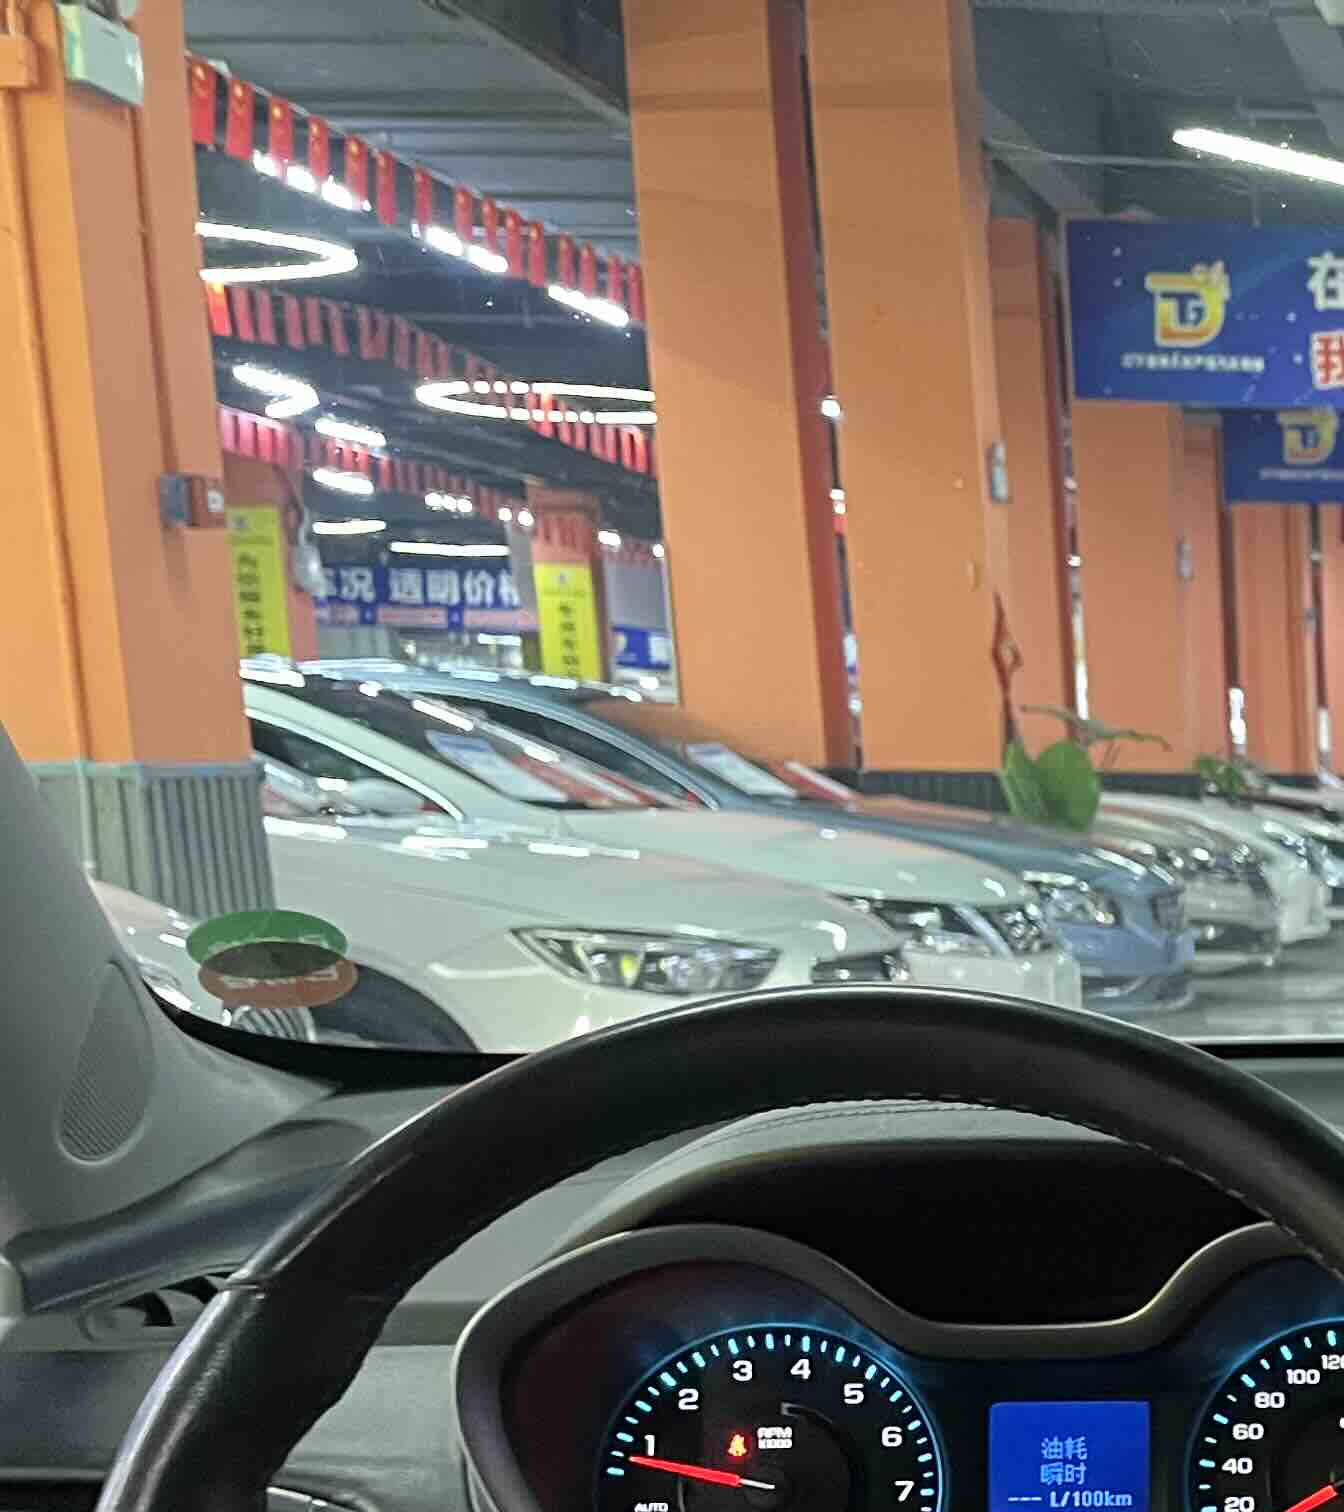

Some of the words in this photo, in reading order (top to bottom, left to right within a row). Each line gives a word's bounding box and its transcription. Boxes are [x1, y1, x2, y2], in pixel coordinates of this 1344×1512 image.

[733, 1361, 752, 1381] 3
[791, 1359, 811, 1379] 4
[1286, 1369, 1320, 1385] 100
[678, 1389, 699, 1410] 2
[844, 1383, 864, 1404] 5
[1254, 1392, 1285, 1409] 80
[881, 1427, 902, 1447] 6
[1232, 1423, 1264, 1440] 60
[645, 1435, 655, 1456] 1
[1041, 1435, 1088, 1460] 油耗
[1040, 1461, 1087, 1485] 瞬时
[1222, 1457, 1253, 1475] 40
[895, 1481, 914, 1502] 7
[1049, 1490, 1133, 1508] L/100km
[634, 1502, 668, 1512] AUTO
